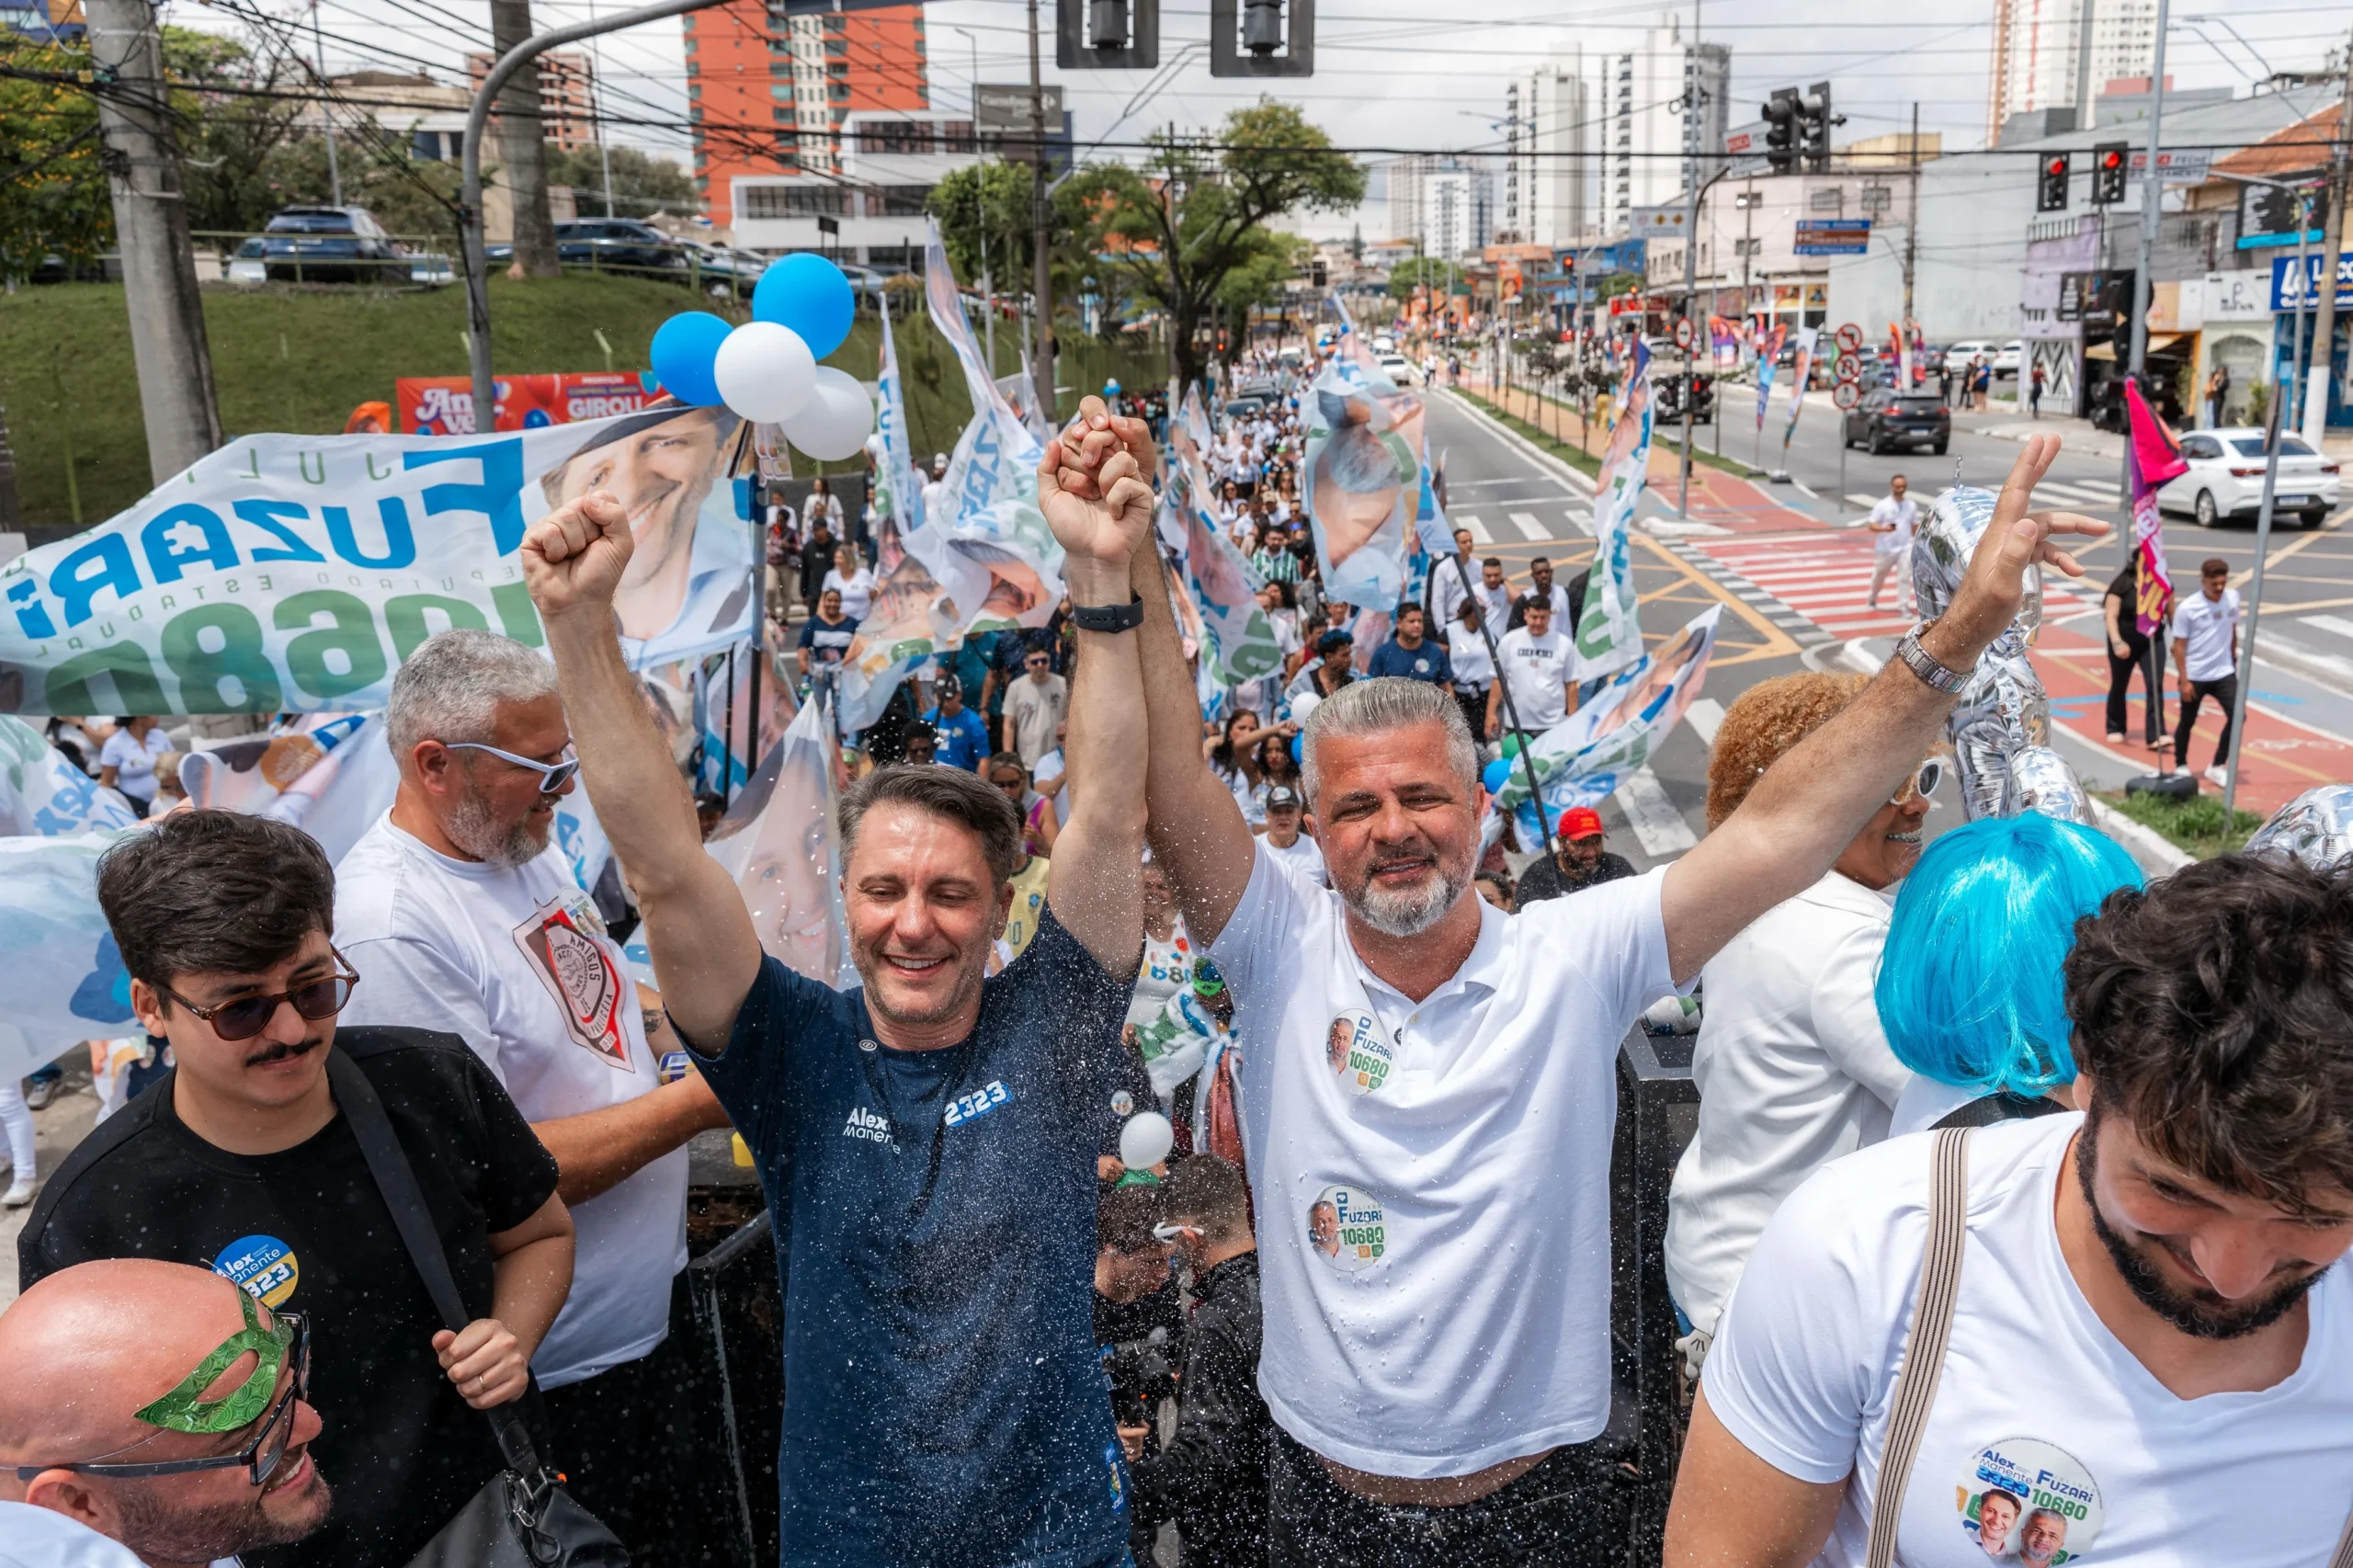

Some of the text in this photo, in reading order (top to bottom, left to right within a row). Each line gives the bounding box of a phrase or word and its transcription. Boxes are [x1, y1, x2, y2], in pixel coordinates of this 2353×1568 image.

[570, 934, 600, 982] AMIGOS
[1349, 1051, 1390, 1078] 10680
[847, 1107, 889, 1131] Alex
[944, 1080, 1013, 1128] 2323
[843, 1125, 902, 1154] Manene
[1340, 1226, 1385, 1245] 10680
[233, 1248, 280, 1284] anente
[243, 1262, 292, 1299] 323
[1979, 1458, 2034, 1485] Manente
[1982, 1449, 2017, 1471] Alex
[1975, 1464, 2031, 1499] 2323
[2031, 1488, 2088, 1521] 10680
